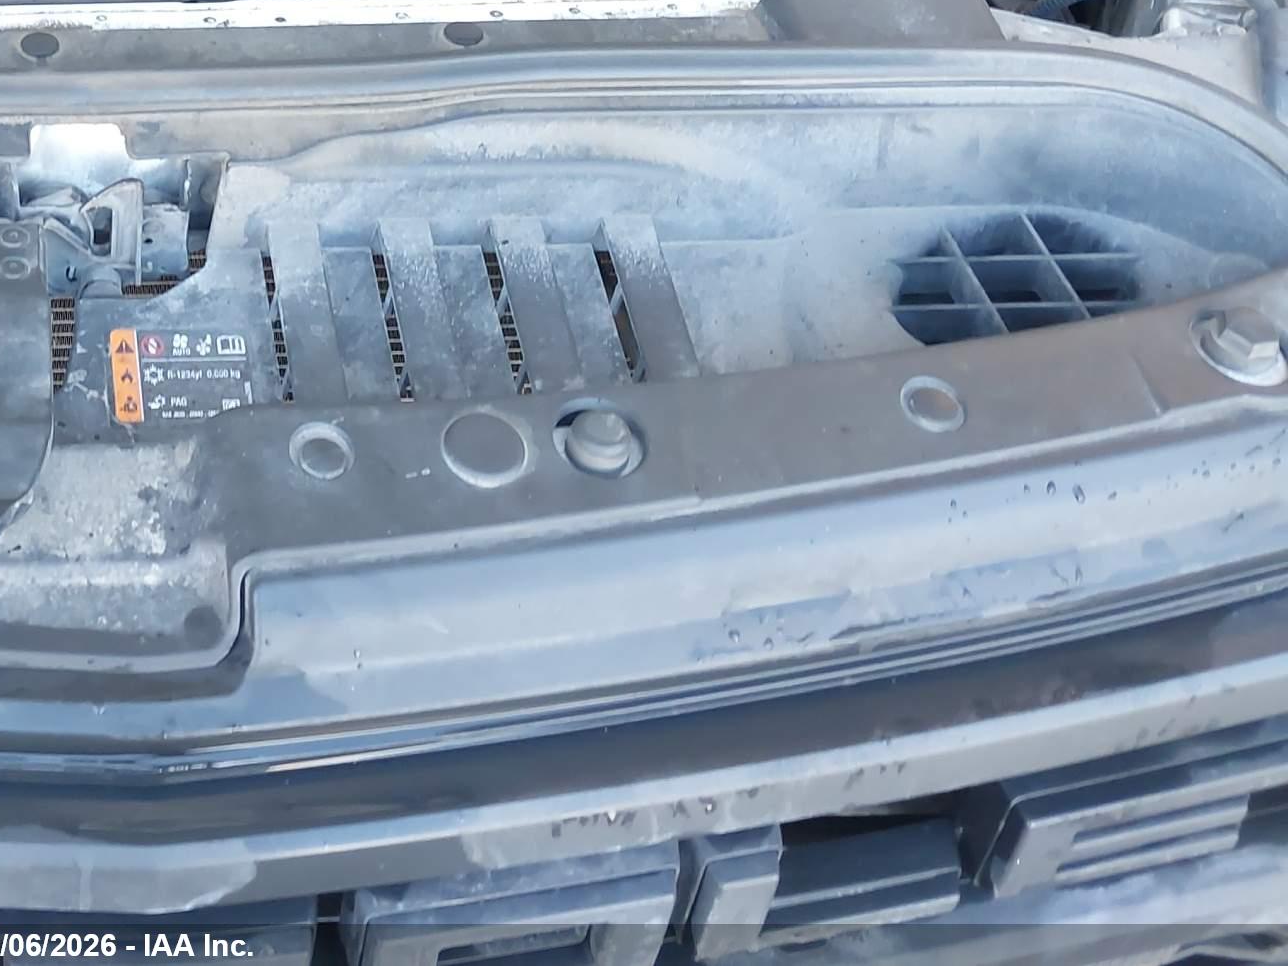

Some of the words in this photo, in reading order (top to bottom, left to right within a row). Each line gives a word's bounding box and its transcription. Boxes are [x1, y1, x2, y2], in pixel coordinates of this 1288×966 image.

[172, 348, 191, 356] AUTO
[230, 368, 241, 379] kg
[170, 396, 187, 407] PAG
